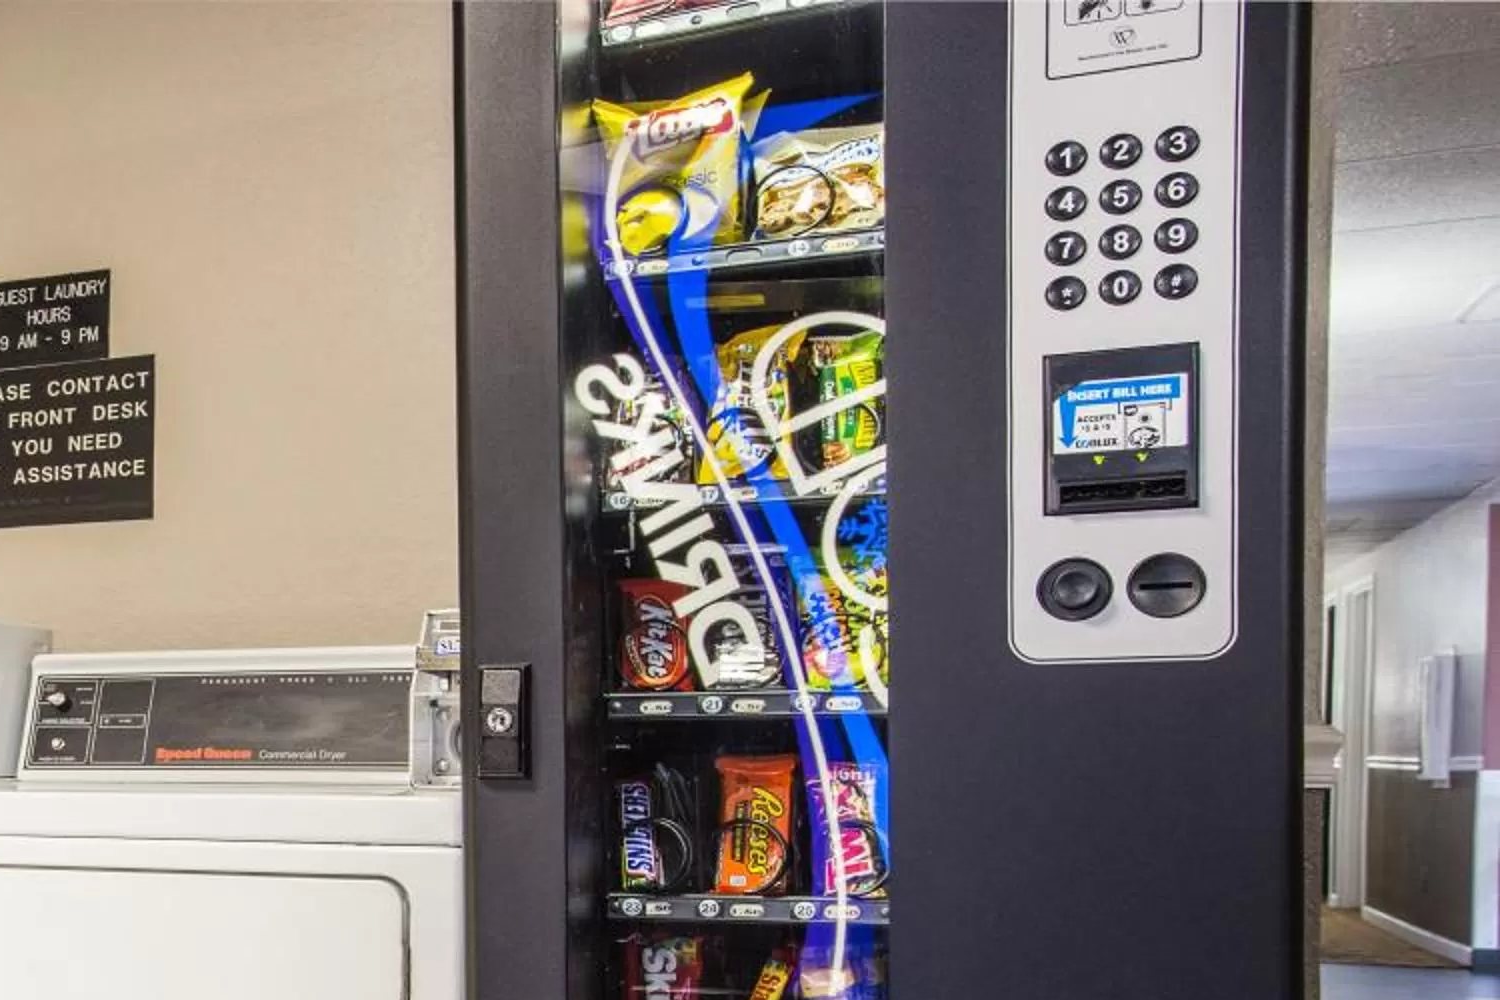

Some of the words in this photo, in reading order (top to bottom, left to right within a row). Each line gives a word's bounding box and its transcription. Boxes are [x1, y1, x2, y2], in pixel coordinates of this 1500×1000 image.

[1059, 147, 1072, 168] 1
[1113, 139, 1129, 160] 2
[1169, 132, 1187, 153] 3
[1058, 191, 1075, 212] 4
[1113, 185, 1128, 207] 5
[1168, 178, 1186, 200] 6
[1059, 238, 1073, 259] 7
[1113, 231, 1129, 252] 8
[1168, 224, 1186, 246] 9
[44, 279, 107, 301] LAUNDRY
[1113, 277, 1128, 298] 0
[27, 306, 71, 326] HOURS
[0, 335, 9, 351] 9
[17, 333, 38, 350] AM
[61, 329, 71, 345] 9
[79, 326, 99, 343] PM
[47, 371, 149, 398] CONTACT
[1112, 385, 1138, 399] BILL
[1140, 383, 1173, 397] HERE
[8, 407, 77, 429] FRONT
[93, 401, 148, 421] DESK
[12, 437, 53, 457] YOU
[68, 432, 123, 452] NEED
[14, 459, 146, 485] ASSISTANCE
[258, 749, 317, 760] Commercial
[318, 749, 347, 762] Dryer
